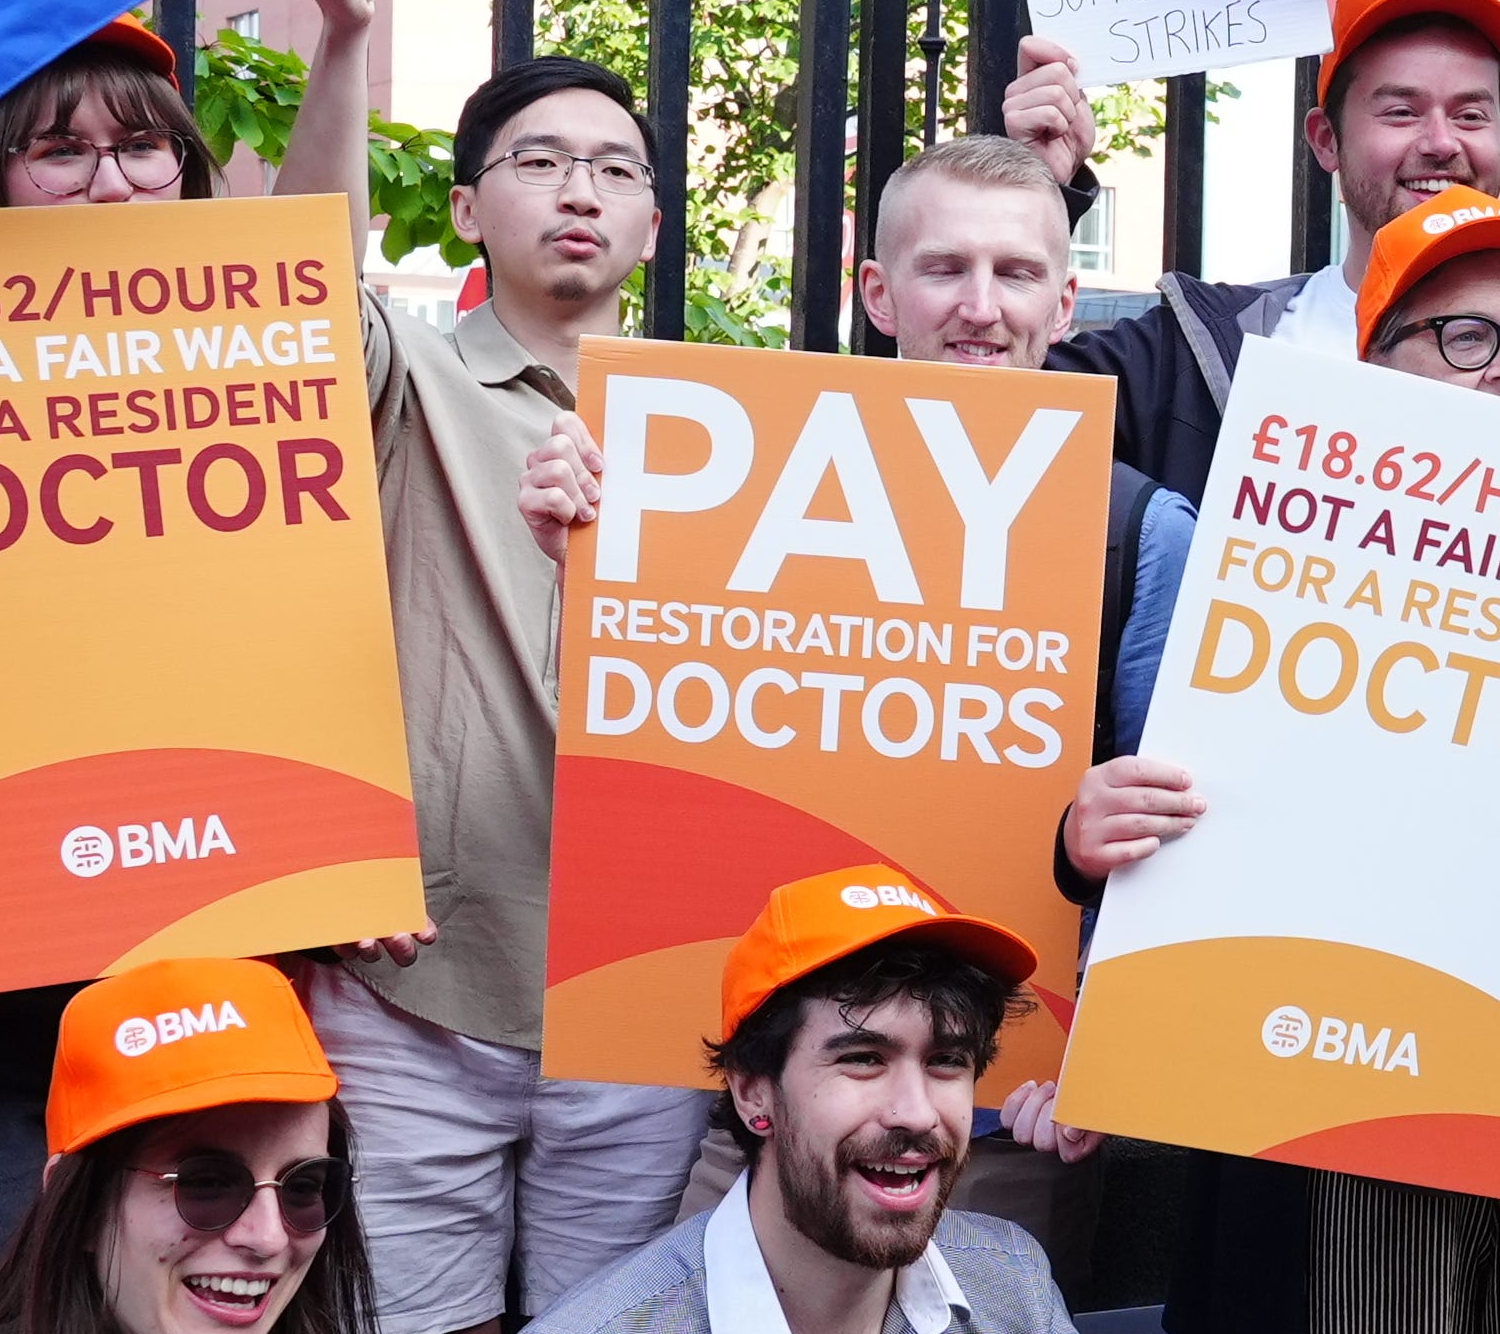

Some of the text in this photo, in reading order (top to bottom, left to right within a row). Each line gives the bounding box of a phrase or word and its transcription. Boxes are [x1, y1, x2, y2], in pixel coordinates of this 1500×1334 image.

[1110, 0, 1266, 63] STRIKES
[277, 260, 327, 306] IS
[36, 331, 163, 380] FAIR
[174, 320, 335, 370] WAGE
[46, 378, 337, 439] RESIDENT
[595, 374, 1083, 611] PAY
[1233, 476, 1355, 541] NOT
[1358, 510, 1395, 556] A
[1217, 537, 1335, 604] FOR
[1344, 570, 1382, 616] A
[592, 597, 1069, 673] RESTORATION FOR
[586, 656, 1063, 768] DOCTORS
[118, 815, 236, 867] BMA
[156, 1001, 246, 1044] BMA
[1313, 1017, 1418, 1076] BMA
